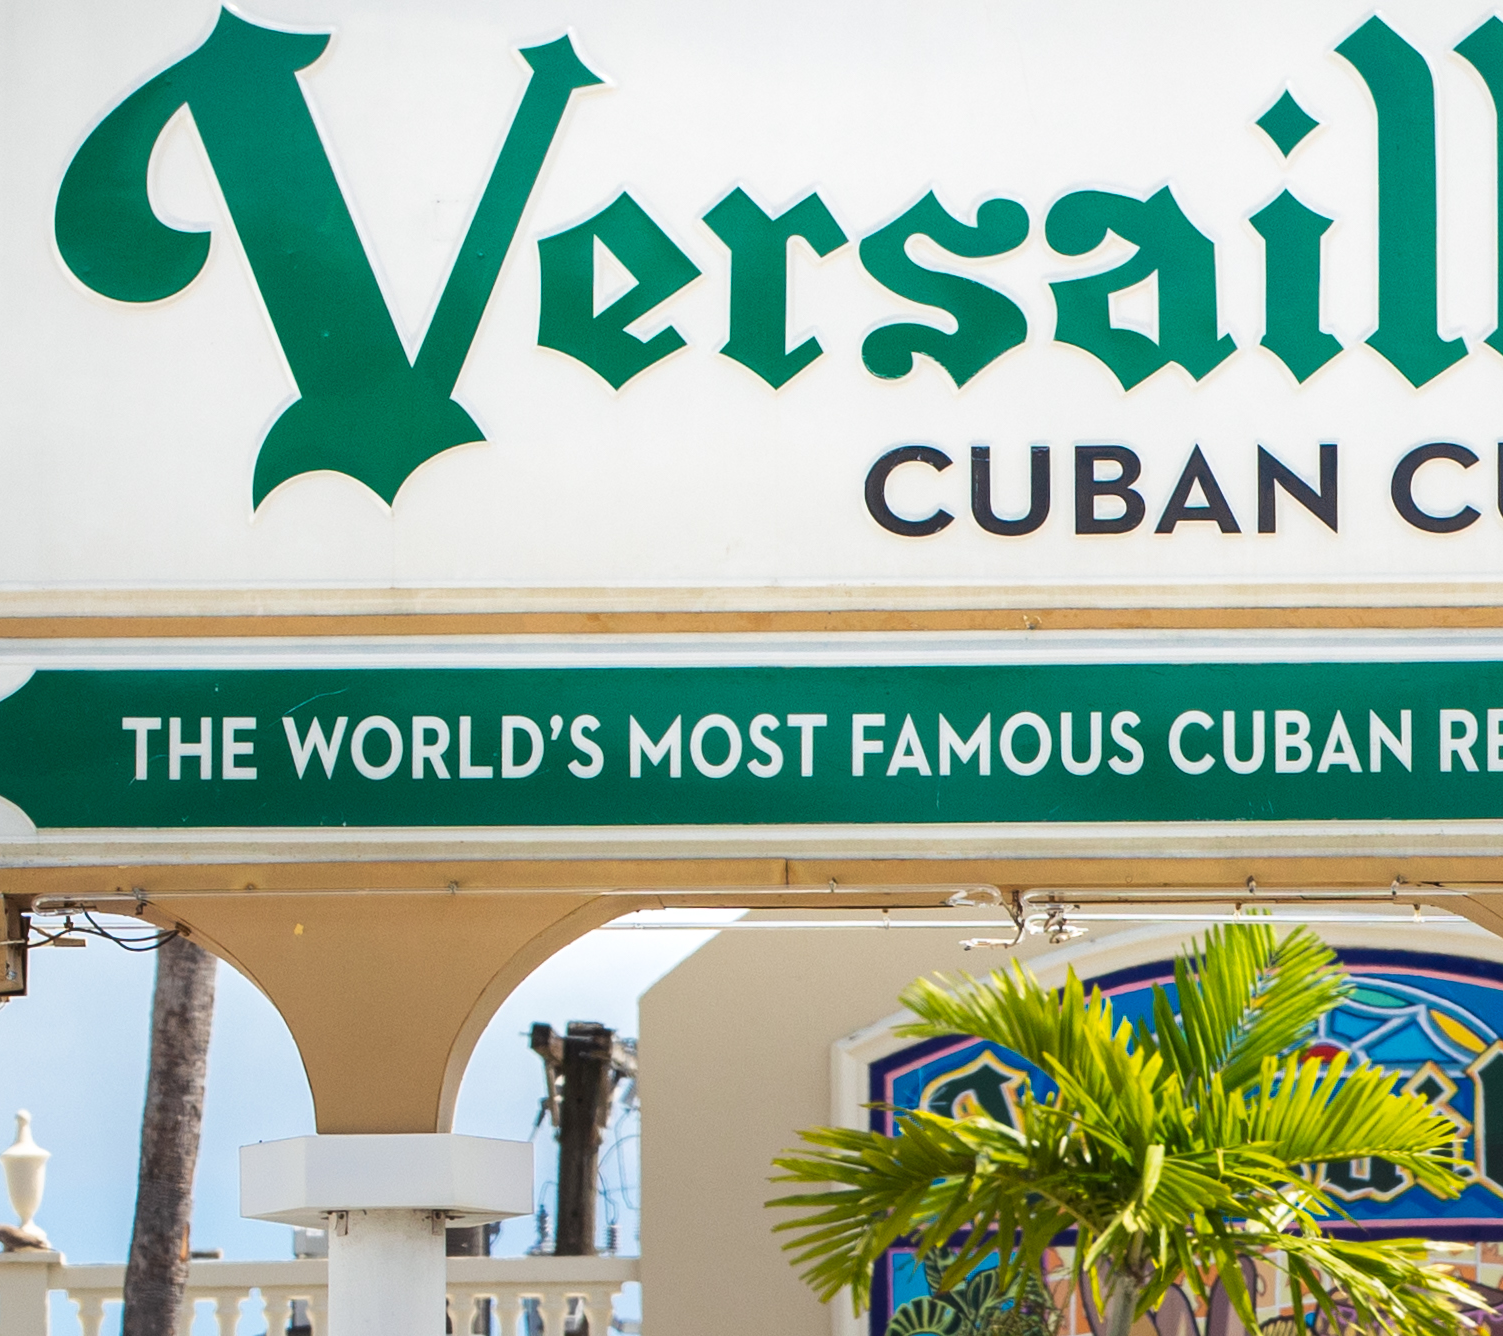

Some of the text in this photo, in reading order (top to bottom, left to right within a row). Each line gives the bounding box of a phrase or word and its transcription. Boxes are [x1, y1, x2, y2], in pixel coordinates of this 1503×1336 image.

[863, 443, 1339, 538] CUBAN
[121, 716, 258, 781] THE
[281, 713, 605, 781] WORLD'S
[628, 712, 828, 779] MOST
[851, 709, 1145, 777] FAMOUS
[1167, 708, 1413, 775] CUBAN
